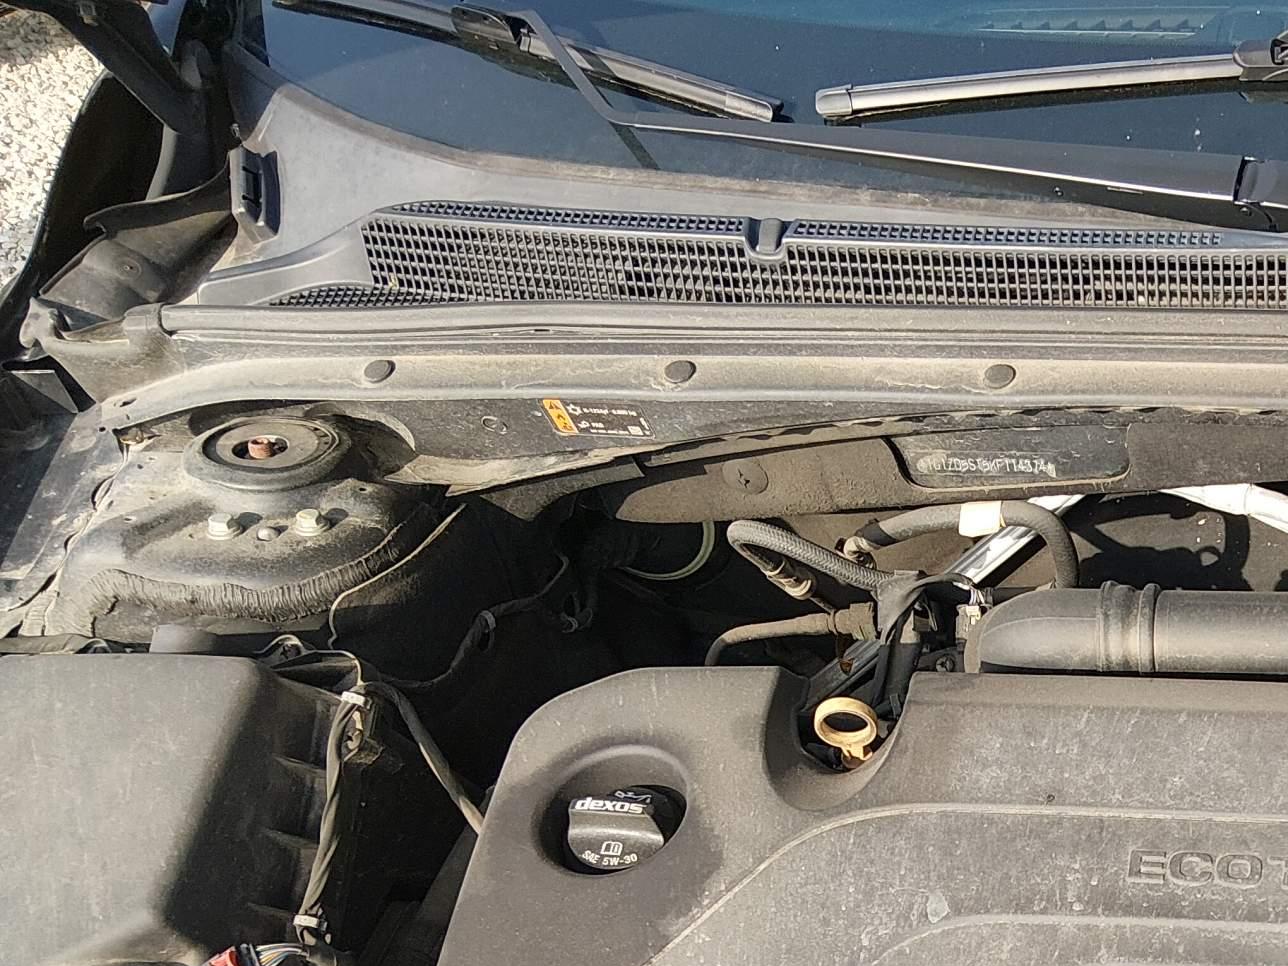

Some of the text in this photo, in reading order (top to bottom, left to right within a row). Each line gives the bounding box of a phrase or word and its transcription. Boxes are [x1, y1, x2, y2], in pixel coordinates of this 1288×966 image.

[575, 797, 647, 814] dexos
[582, 850, 638, 866] SAE 5W-30
